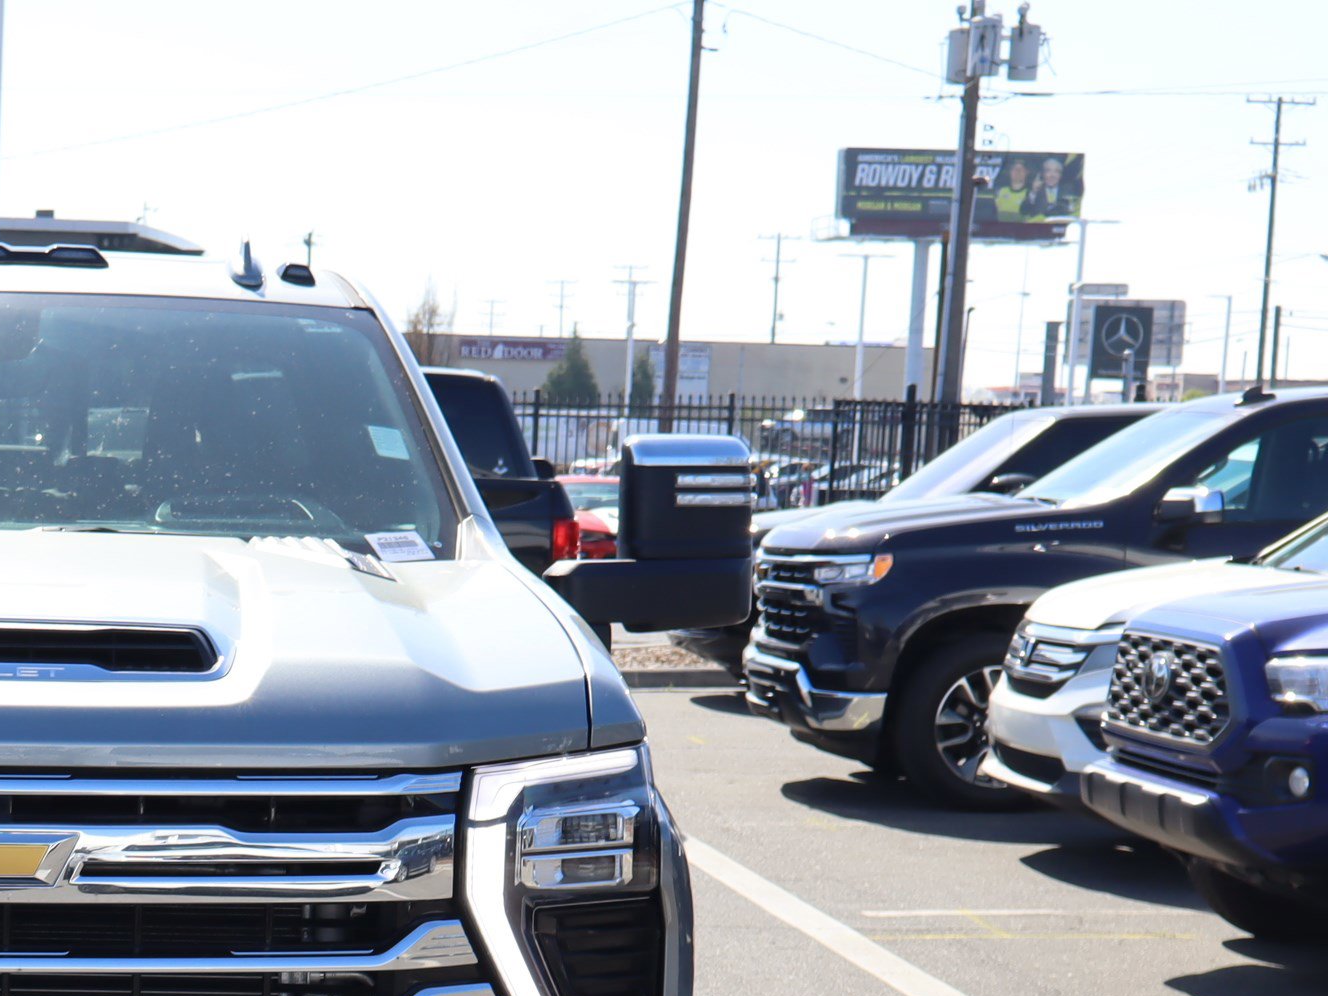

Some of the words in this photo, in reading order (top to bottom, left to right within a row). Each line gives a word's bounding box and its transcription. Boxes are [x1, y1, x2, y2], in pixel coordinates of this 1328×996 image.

[854, 163, 922, 187] ROWDY
[923, 165, 937, 188] &
[460, 346, 492, 359] RED
[504, 347, 544, 360] DOOR
[1015, 520, 1104, 533] SILVERADO
